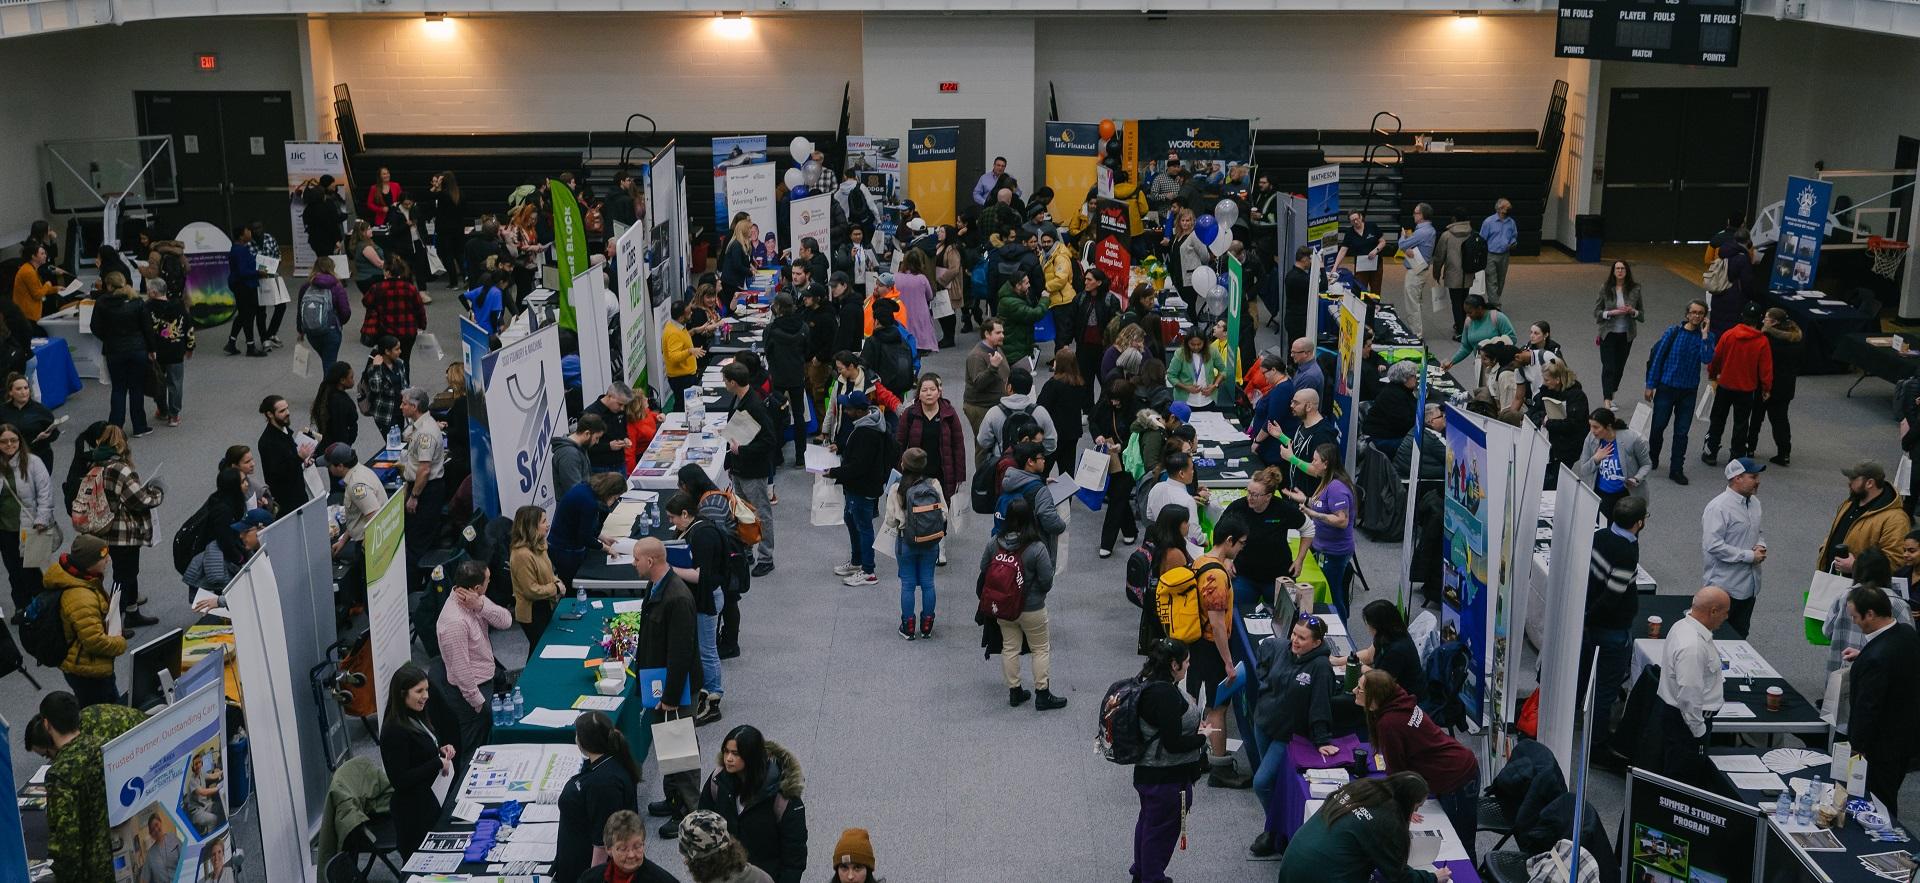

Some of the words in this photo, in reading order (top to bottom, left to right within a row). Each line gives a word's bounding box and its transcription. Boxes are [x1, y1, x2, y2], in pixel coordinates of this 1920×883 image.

[1560, 8, 1570, 17] TM
[1572, 9, 1594, 18] FOULS
[1620, 10, 1646, 20] PLAYER
[1653, 12, 1676, 22] FOULS
[1700, 14, 1711, 22] TM
[1714, 14, 1736, 24] FOULS
[1564, 46, 1584, 54] POINTS
[1632, 50, 1652, 58] MATCH
[201, 56, 215, 68] EXIT
[1702, 53, 1726, 62] POINTS
[1168, 140, 1221, 149] WORKFORCE
[929, 146, 956, 155] Financial
[1311, 171, 1336, 181] MATHESON
[564, 206, 574, 252] BLOCK
[1161, 602, 1170, 622] THE
[107, 750, 135, 774] Trusted
[162, 713, 202, 740] Outstanding
[1659, 796, 1690, 813] SUMMER
[1691, 808, 1726, 826] STUDENT
[1674, 814, 1710, 834] PROGRAM
